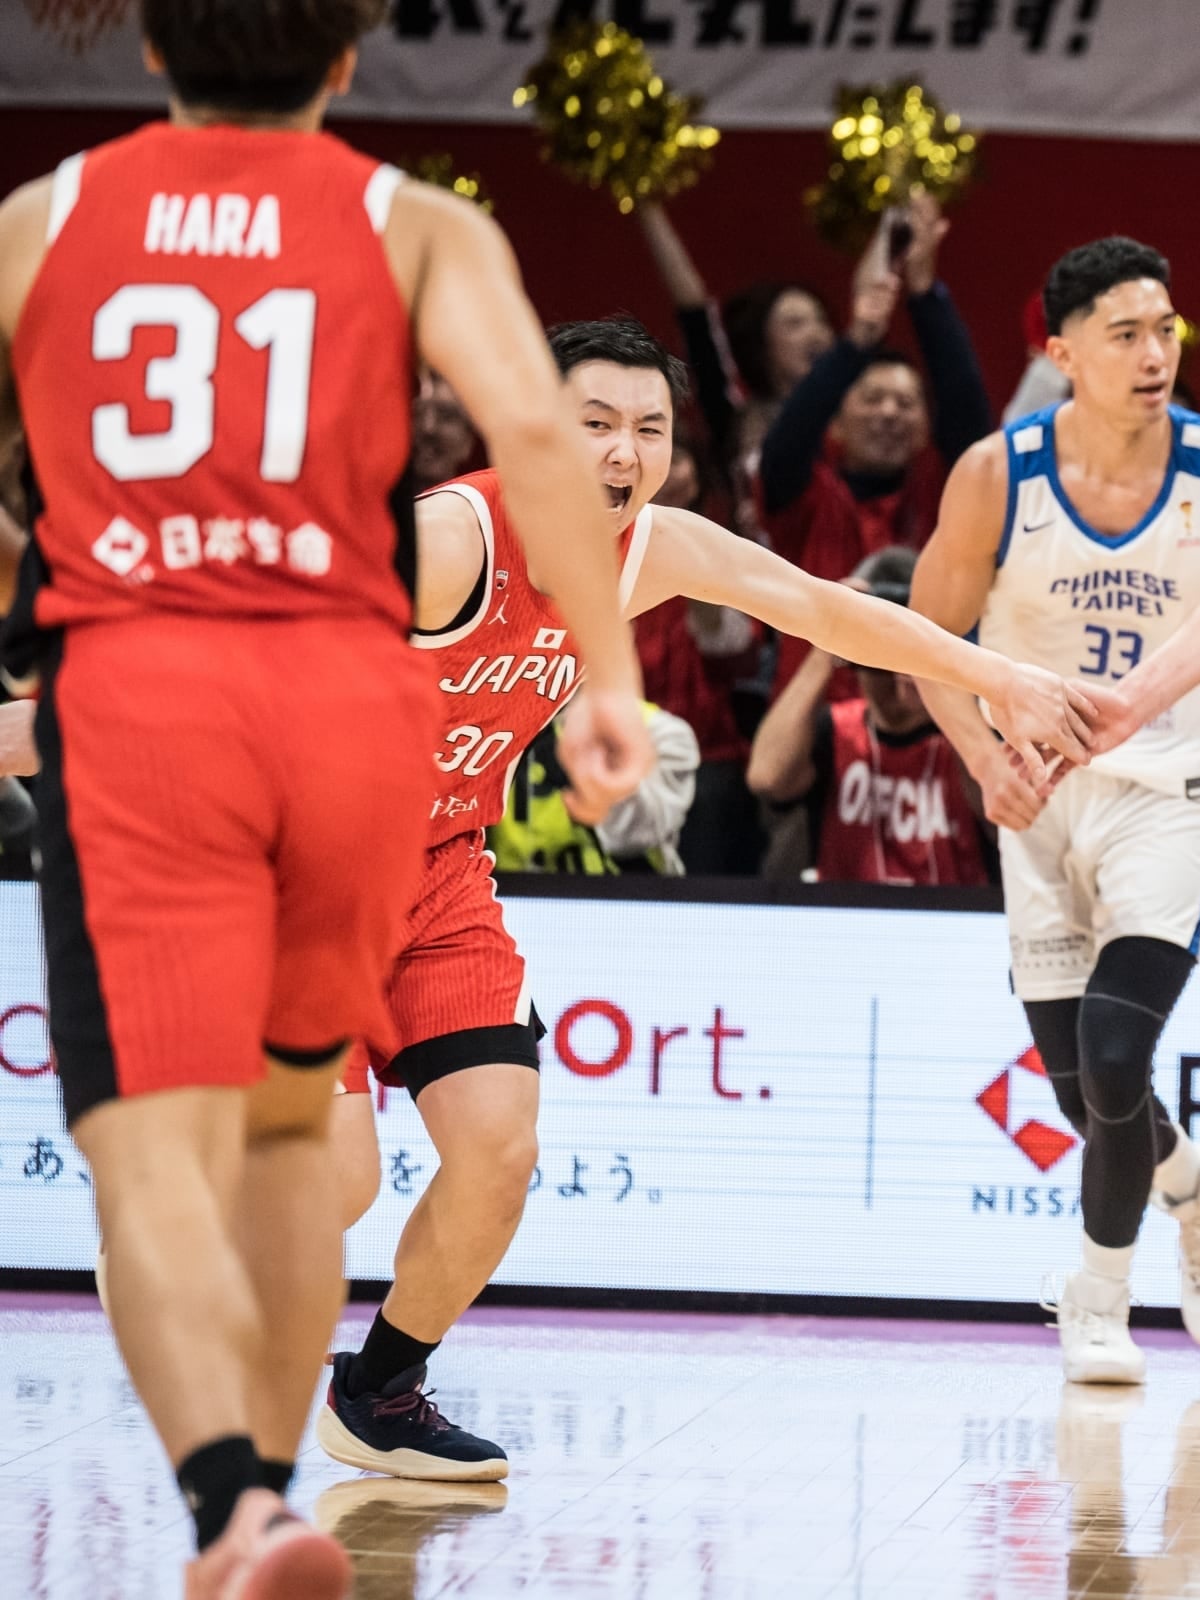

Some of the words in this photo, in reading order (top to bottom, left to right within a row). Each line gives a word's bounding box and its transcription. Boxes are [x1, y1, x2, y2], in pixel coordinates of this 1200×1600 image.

[144, 192, 281, 259] HARA
[91, 284, 317, 484] 31
[1050, 568, 1182, 601] CHINESE
[1079, 623, 1145, 681] 33
[433, 725, 514, 777] 30
